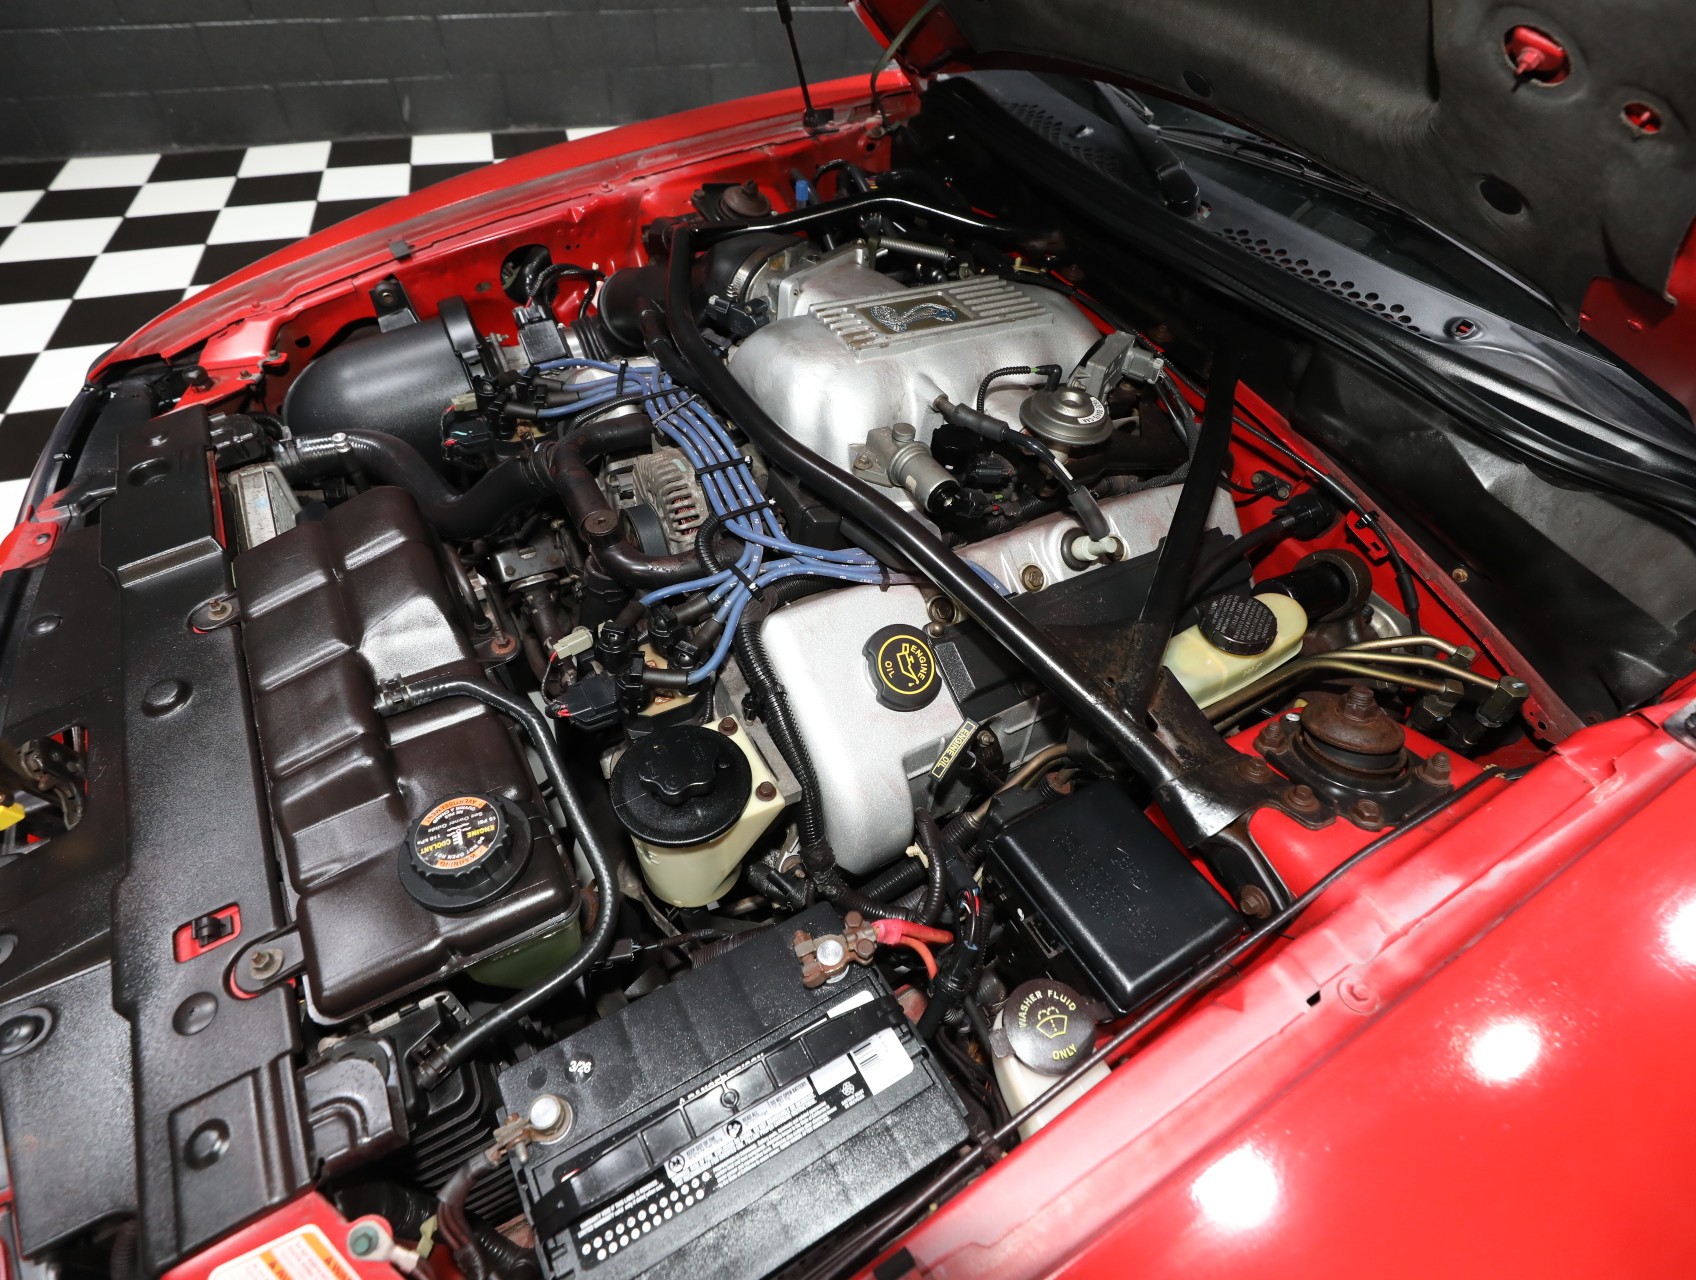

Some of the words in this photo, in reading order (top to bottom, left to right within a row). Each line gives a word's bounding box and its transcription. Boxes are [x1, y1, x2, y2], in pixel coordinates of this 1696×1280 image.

[884, 660, 897, 679] OIL
[910, 644, 928, 681] ENGINE
[946, 729, 971, 759] ENGINE
[937, 755, 951, 769] OIL
[427, 798, 477, 823] AVERTISSEMENT
[427, 824, 448, 833] Guide
[477, 818, 488, 826] PSI
[466, 824, 496, 839] ENGINE
[420, 838, 452, 855] COOLANT
[466, 844, 478, 854] NOT
[439, 853, 476, 867] WARNING
[447, 851, 465, 860] OPEN
[1018, 990, 1043, 1028] WASHER
[1047, 989, 1077, 1011] FLUID
[1052, 1043, 1077, 1061] ONLY
